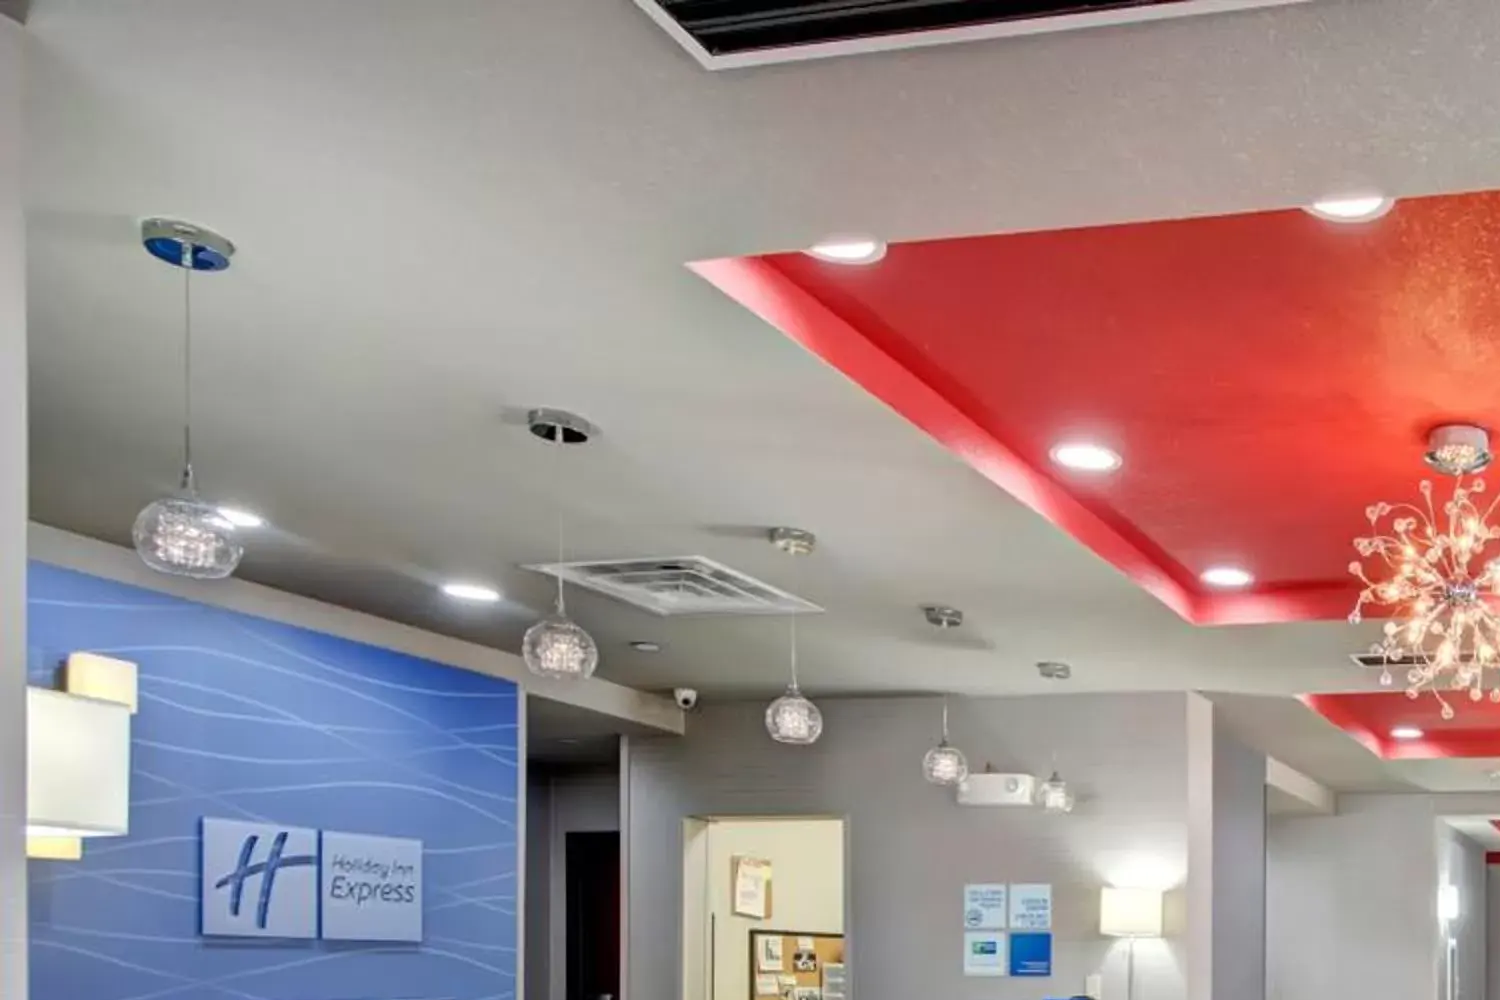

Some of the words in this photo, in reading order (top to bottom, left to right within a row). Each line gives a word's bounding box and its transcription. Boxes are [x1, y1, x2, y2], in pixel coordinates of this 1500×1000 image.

[331, 853, 389, 879] Holiday
[390, 857, 415, 880] Inn
[330, 875, 415, 905] Express
